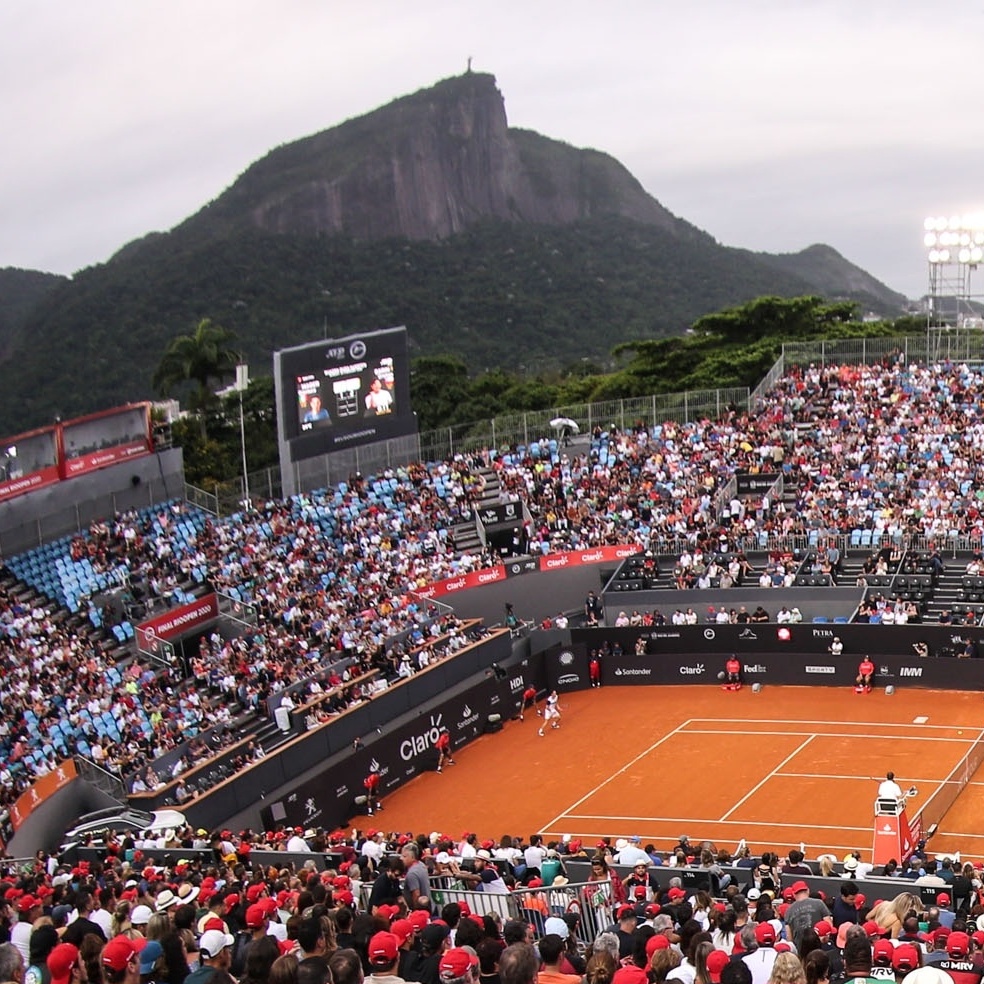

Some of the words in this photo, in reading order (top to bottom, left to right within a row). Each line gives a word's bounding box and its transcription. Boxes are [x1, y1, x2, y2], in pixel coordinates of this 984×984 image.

[581, 551, 603, 562] Claro
[616, 547, 637, 557] Claro
[547, 556, 569, 567] Claro
[478, 569, 500, 583] Claro
[446, 578, 467, 591] Claro
[622, 668, 651, 676] Santander
[680, 663, 706, 675] Claro
[743, 664, 767, 673] FedEx
[900, 667, 922, 677] IMM
[509, 676, 524, 690] HDI
[457, 713, 480, 730] Santander
[400, 717, 446, 761] Claro
[950, 962, 974, 971] MRV
